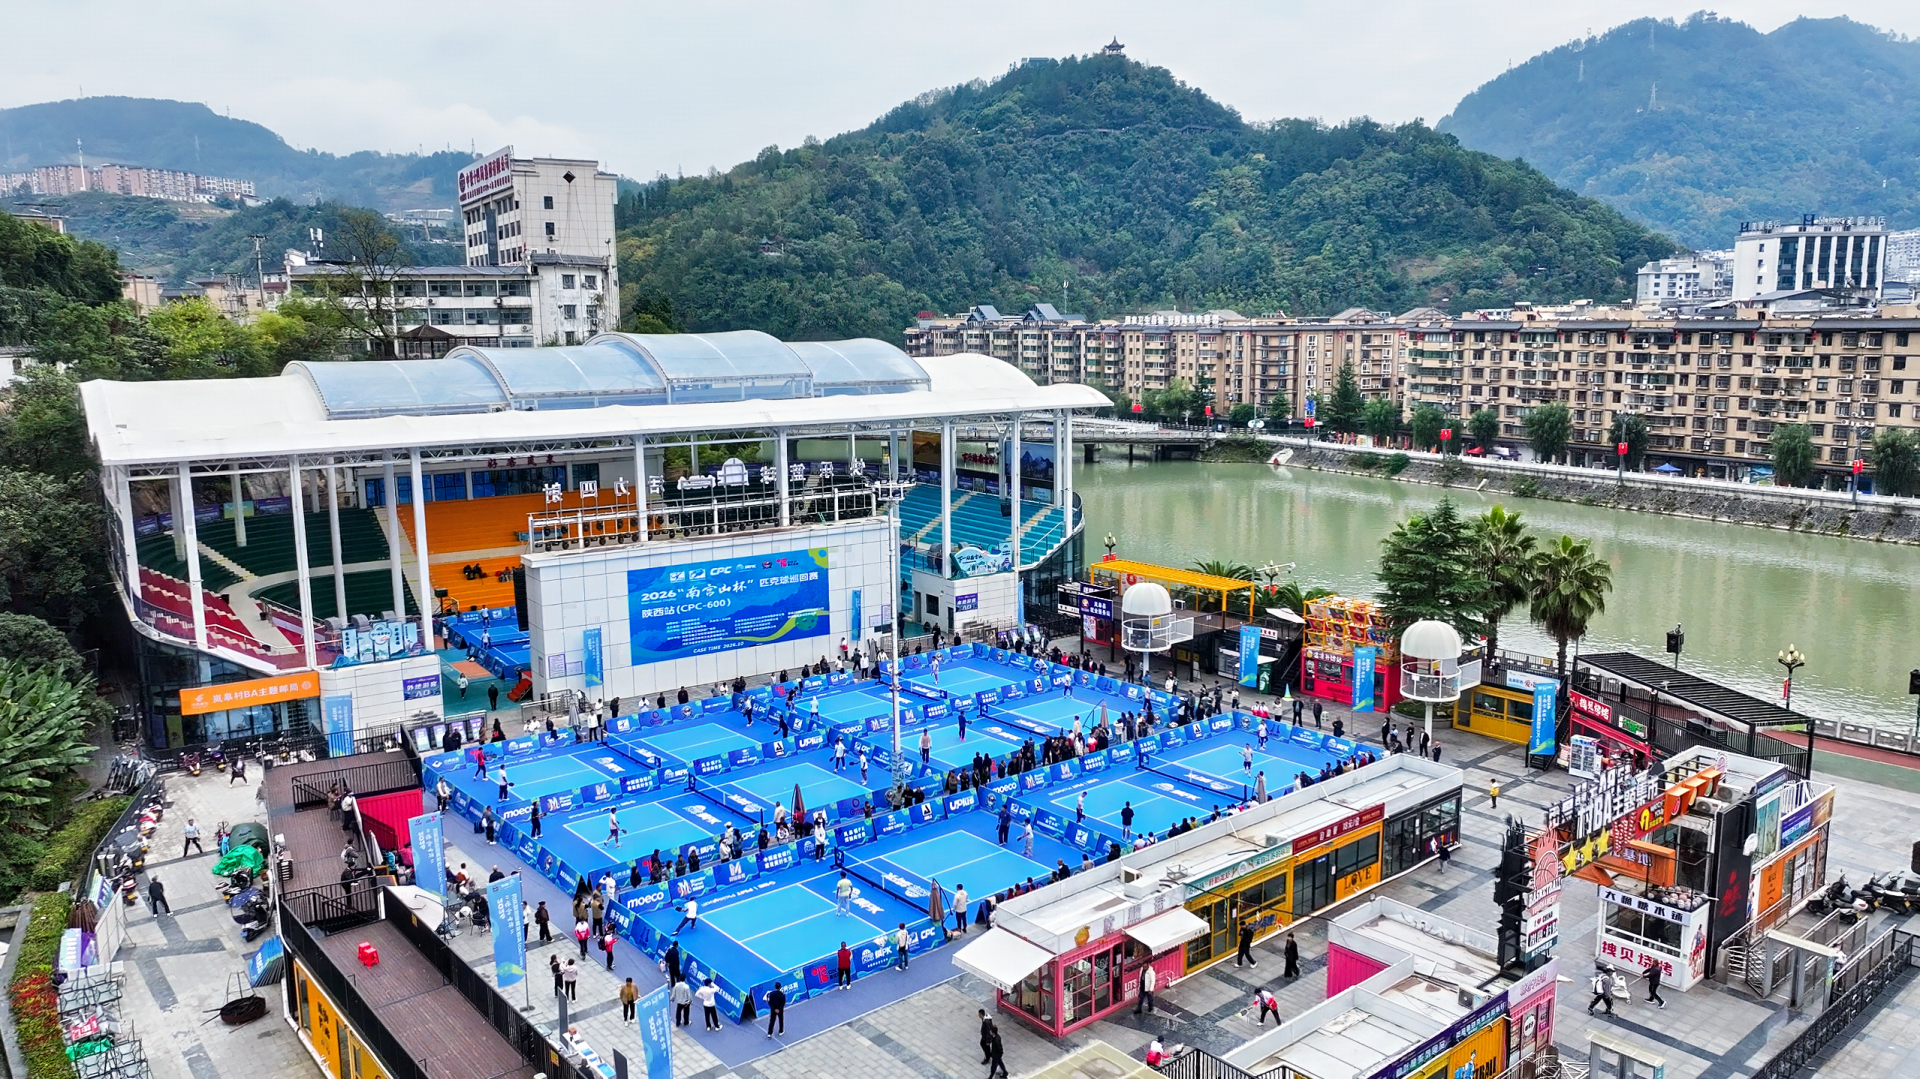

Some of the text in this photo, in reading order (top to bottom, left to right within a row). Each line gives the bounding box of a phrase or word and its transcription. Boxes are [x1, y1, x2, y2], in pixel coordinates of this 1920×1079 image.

[212, 682, 299, 704] 岚皋村BA主题邮局
[627, 891, 665, 909] moeco
[920, 926, 936, 940] CPC
